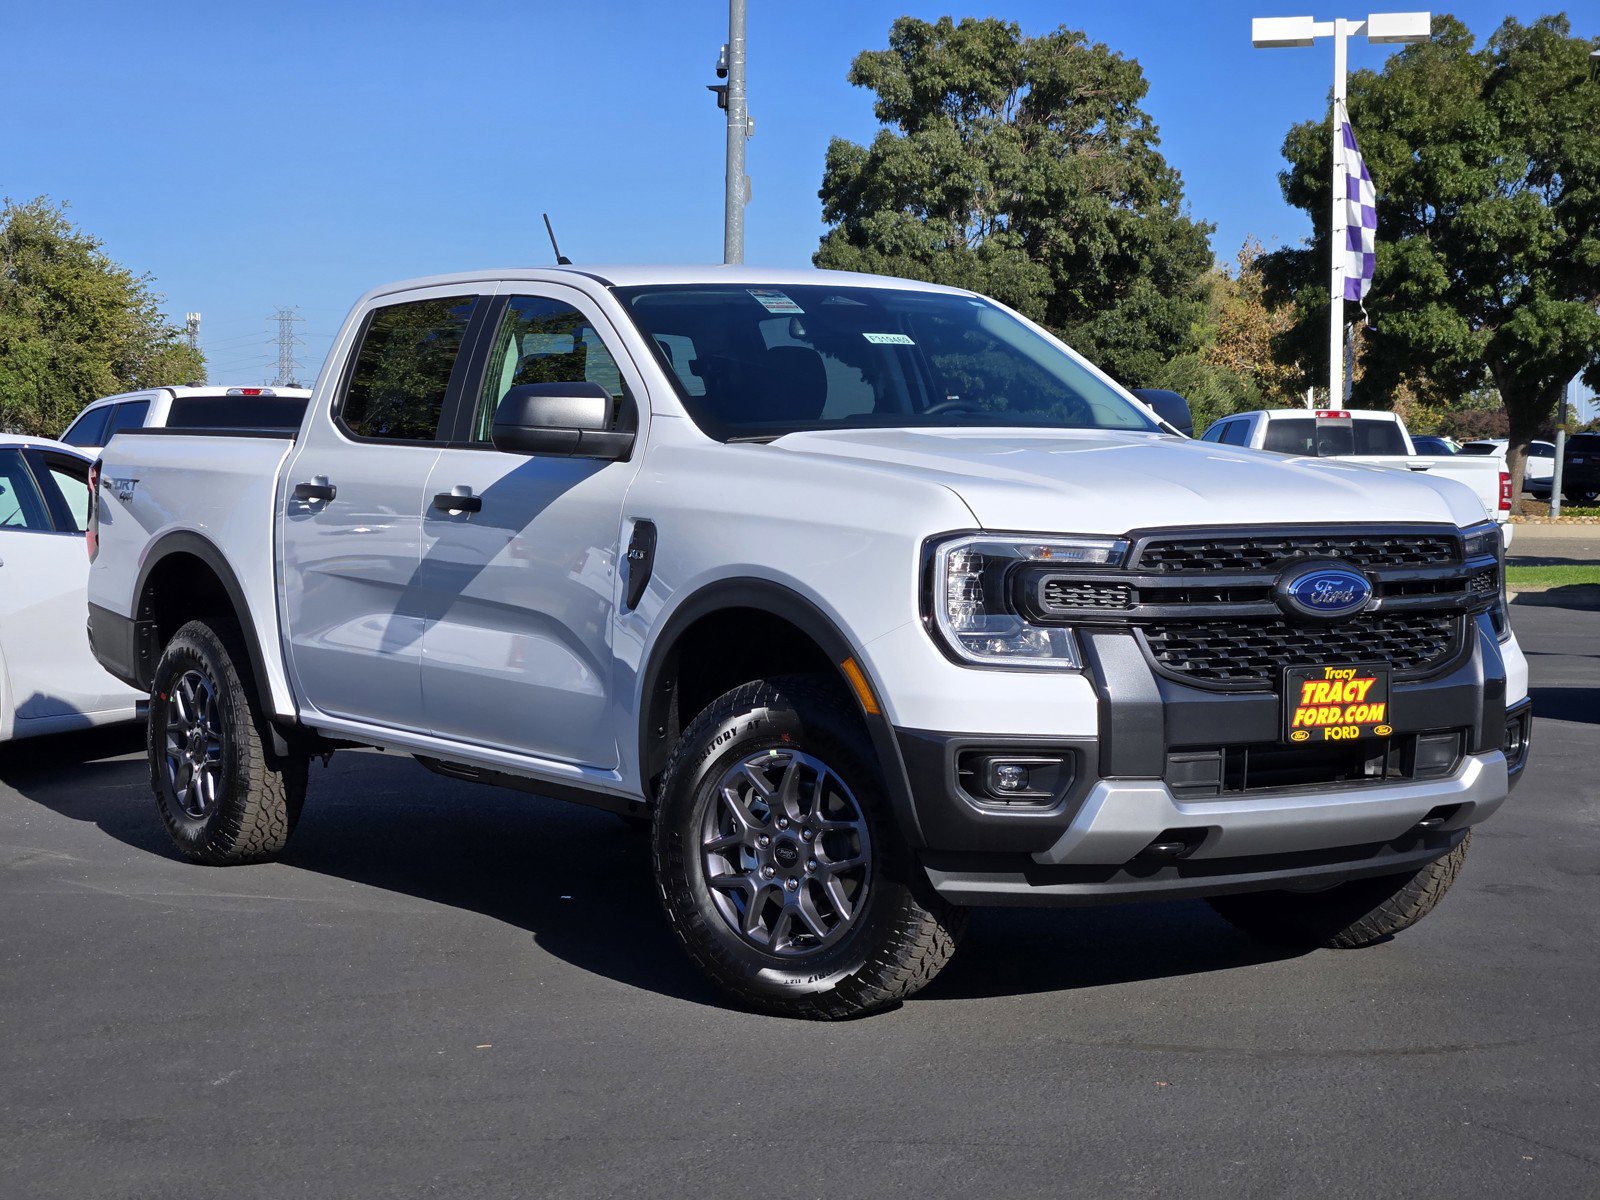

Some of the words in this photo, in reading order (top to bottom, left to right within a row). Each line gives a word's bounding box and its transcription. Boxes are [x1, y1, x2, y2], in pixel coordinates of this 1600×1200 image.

[1311, 579, 1354, 604] Ford
[1324, 666, 1357, 681] Tracy
[1301, 678, 1376, 705] TRACY
[1292, 703, 1386, 727] FORD.COM
[1324, 726, 1360, 740] FORD
